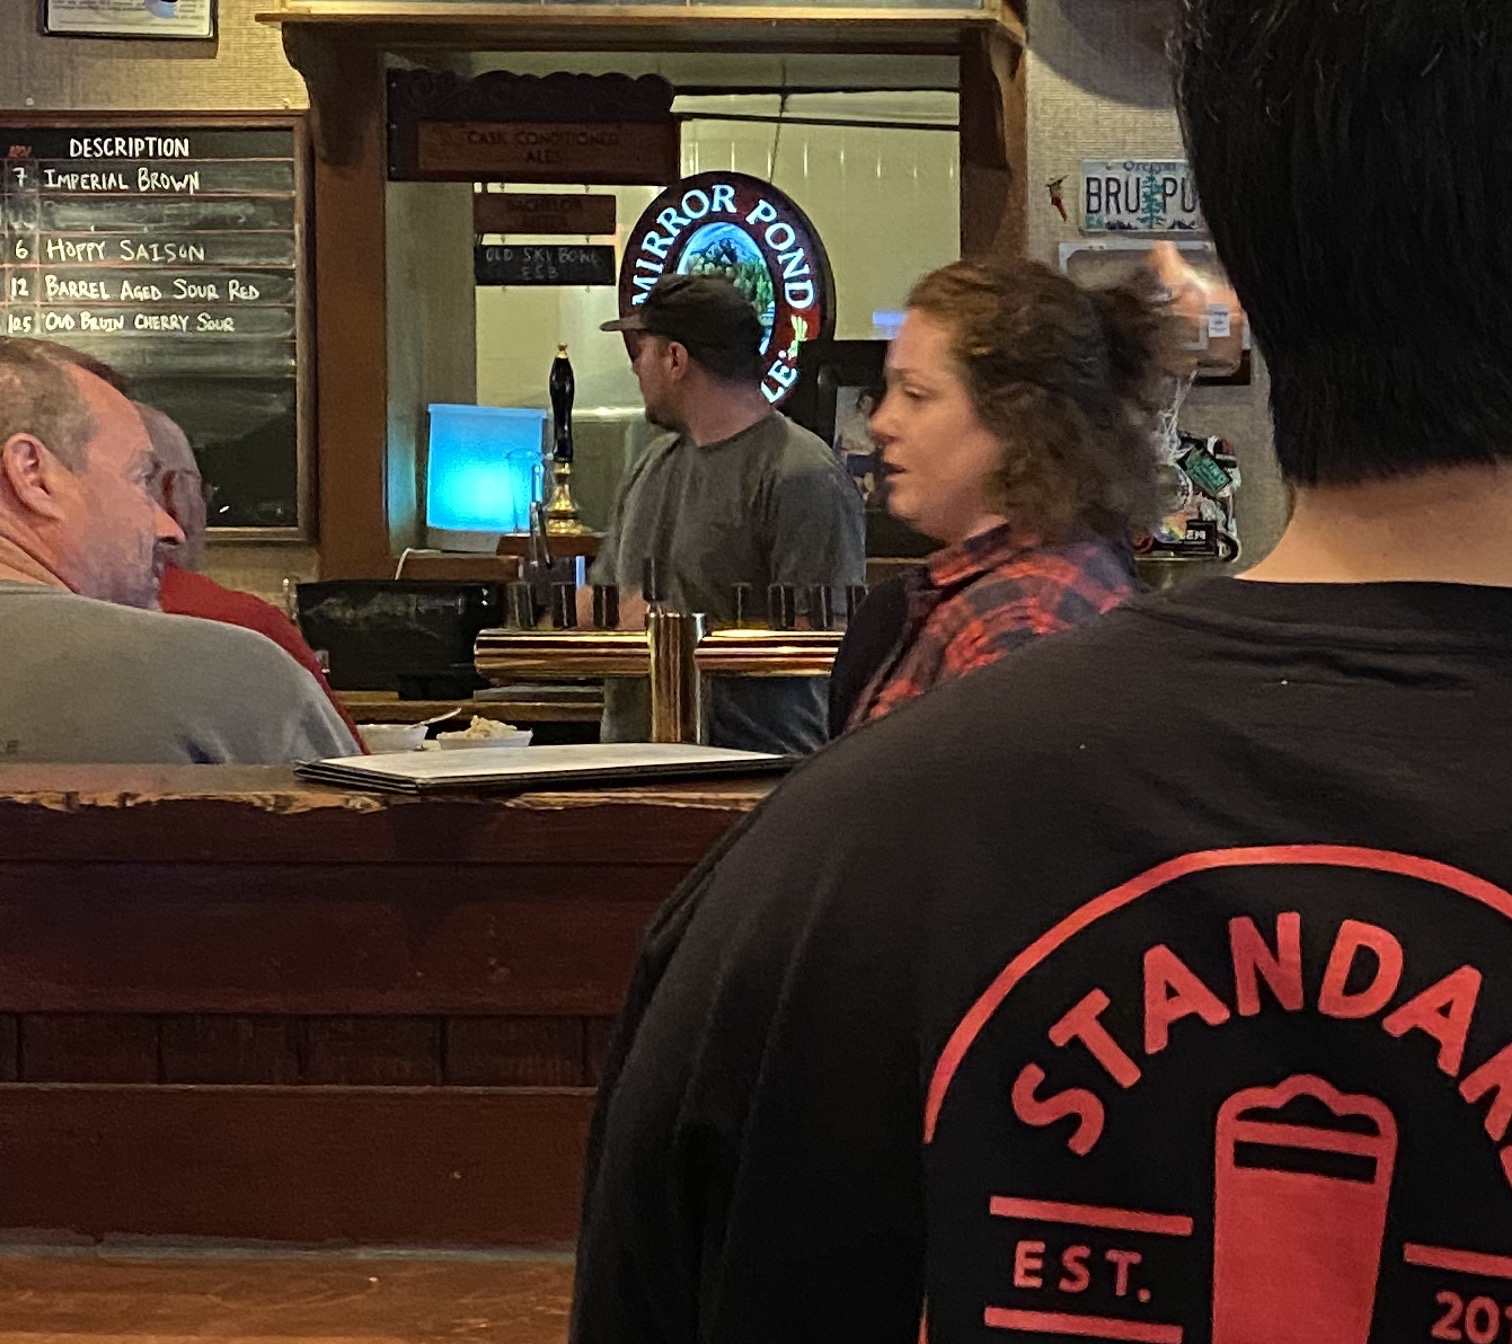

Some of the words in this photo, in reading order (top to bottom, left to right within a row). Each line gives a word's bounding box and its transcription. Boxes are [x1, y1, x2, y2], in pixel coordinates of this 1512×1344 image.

[69, 137, 189, 158] DESCRIPTION
[12, 167, 28, 187] 7
[44, 168, 129, 190] IMPERIAL
[137, 168, 200, 196] BROWN
[1086, 176, 1141, 214] BRU
[15, 239, 29, 259] 6
[46, 238, 106, 262] HOPPY
[119, 239, 205, 261] SAISON
[485, 247, 514, 263] OLD
[523, 246, 552, 263] SKI
[631, 183, 738, 307] MIRROR
[745, 198, 815, 310] POND
[10, 277, 29, 297] 12
[44, 274, 110, 301] BARREL
[119, 279, 162, 301] AGED
[133, 311, 190, 334] CHERRY
[758, 359, 799, 405] LE
[1012, 1240, 1153, 1303] EST.
